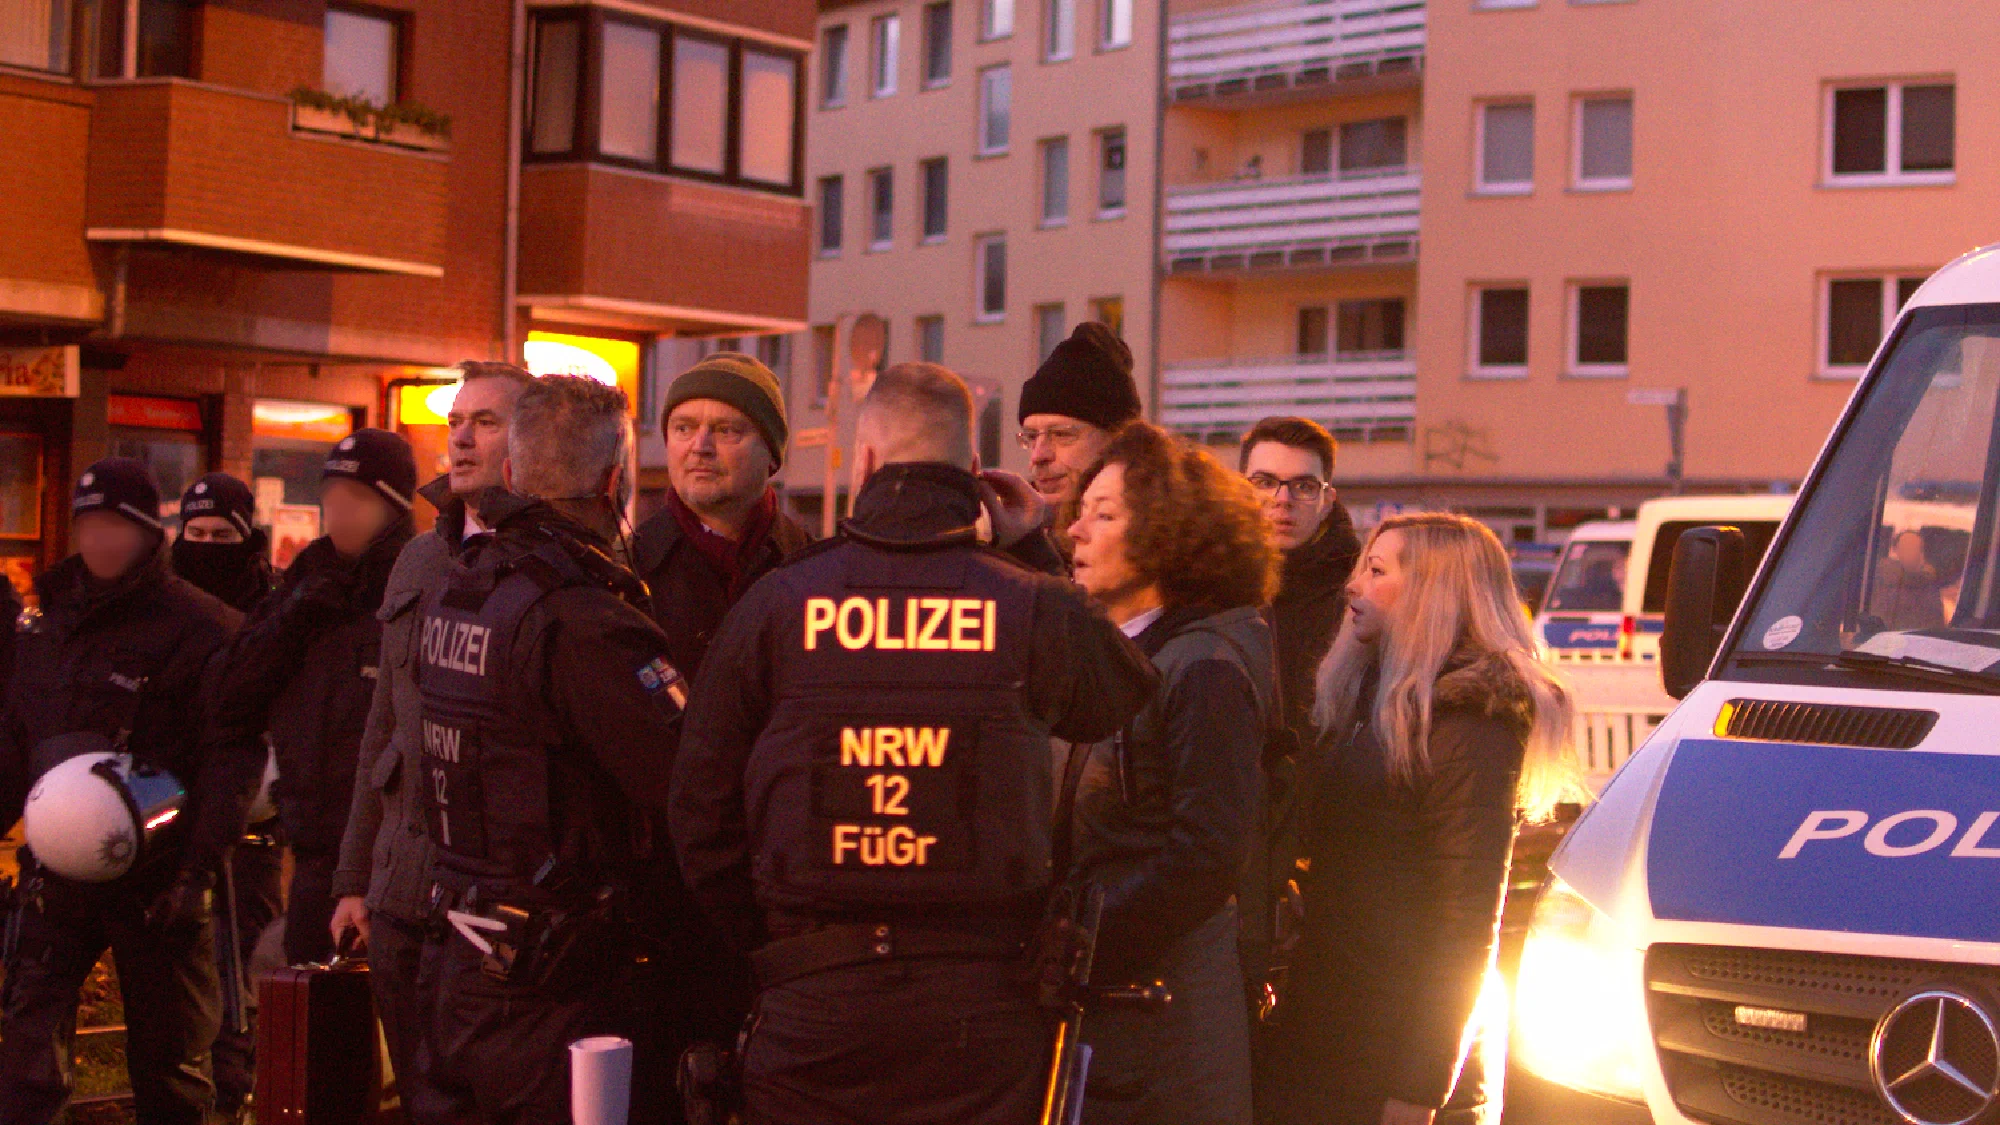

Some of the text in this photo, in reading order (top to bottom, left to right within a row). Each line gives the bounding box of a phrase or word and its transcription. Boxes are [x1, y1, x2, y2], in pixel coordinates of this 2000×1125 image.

[805, 597, 996, 651] POLIZEI
[421, 616, 491, 676] POLIZEI
[423, 719, 460, 763] NRW
[841, 727, 950, 767] NRW
[432, 767, 448, 804] 12
[865, 774, 909, 815] 12
[832, 826, 938, 867] FüGr
[1777, 810, 2000, 859] POL
